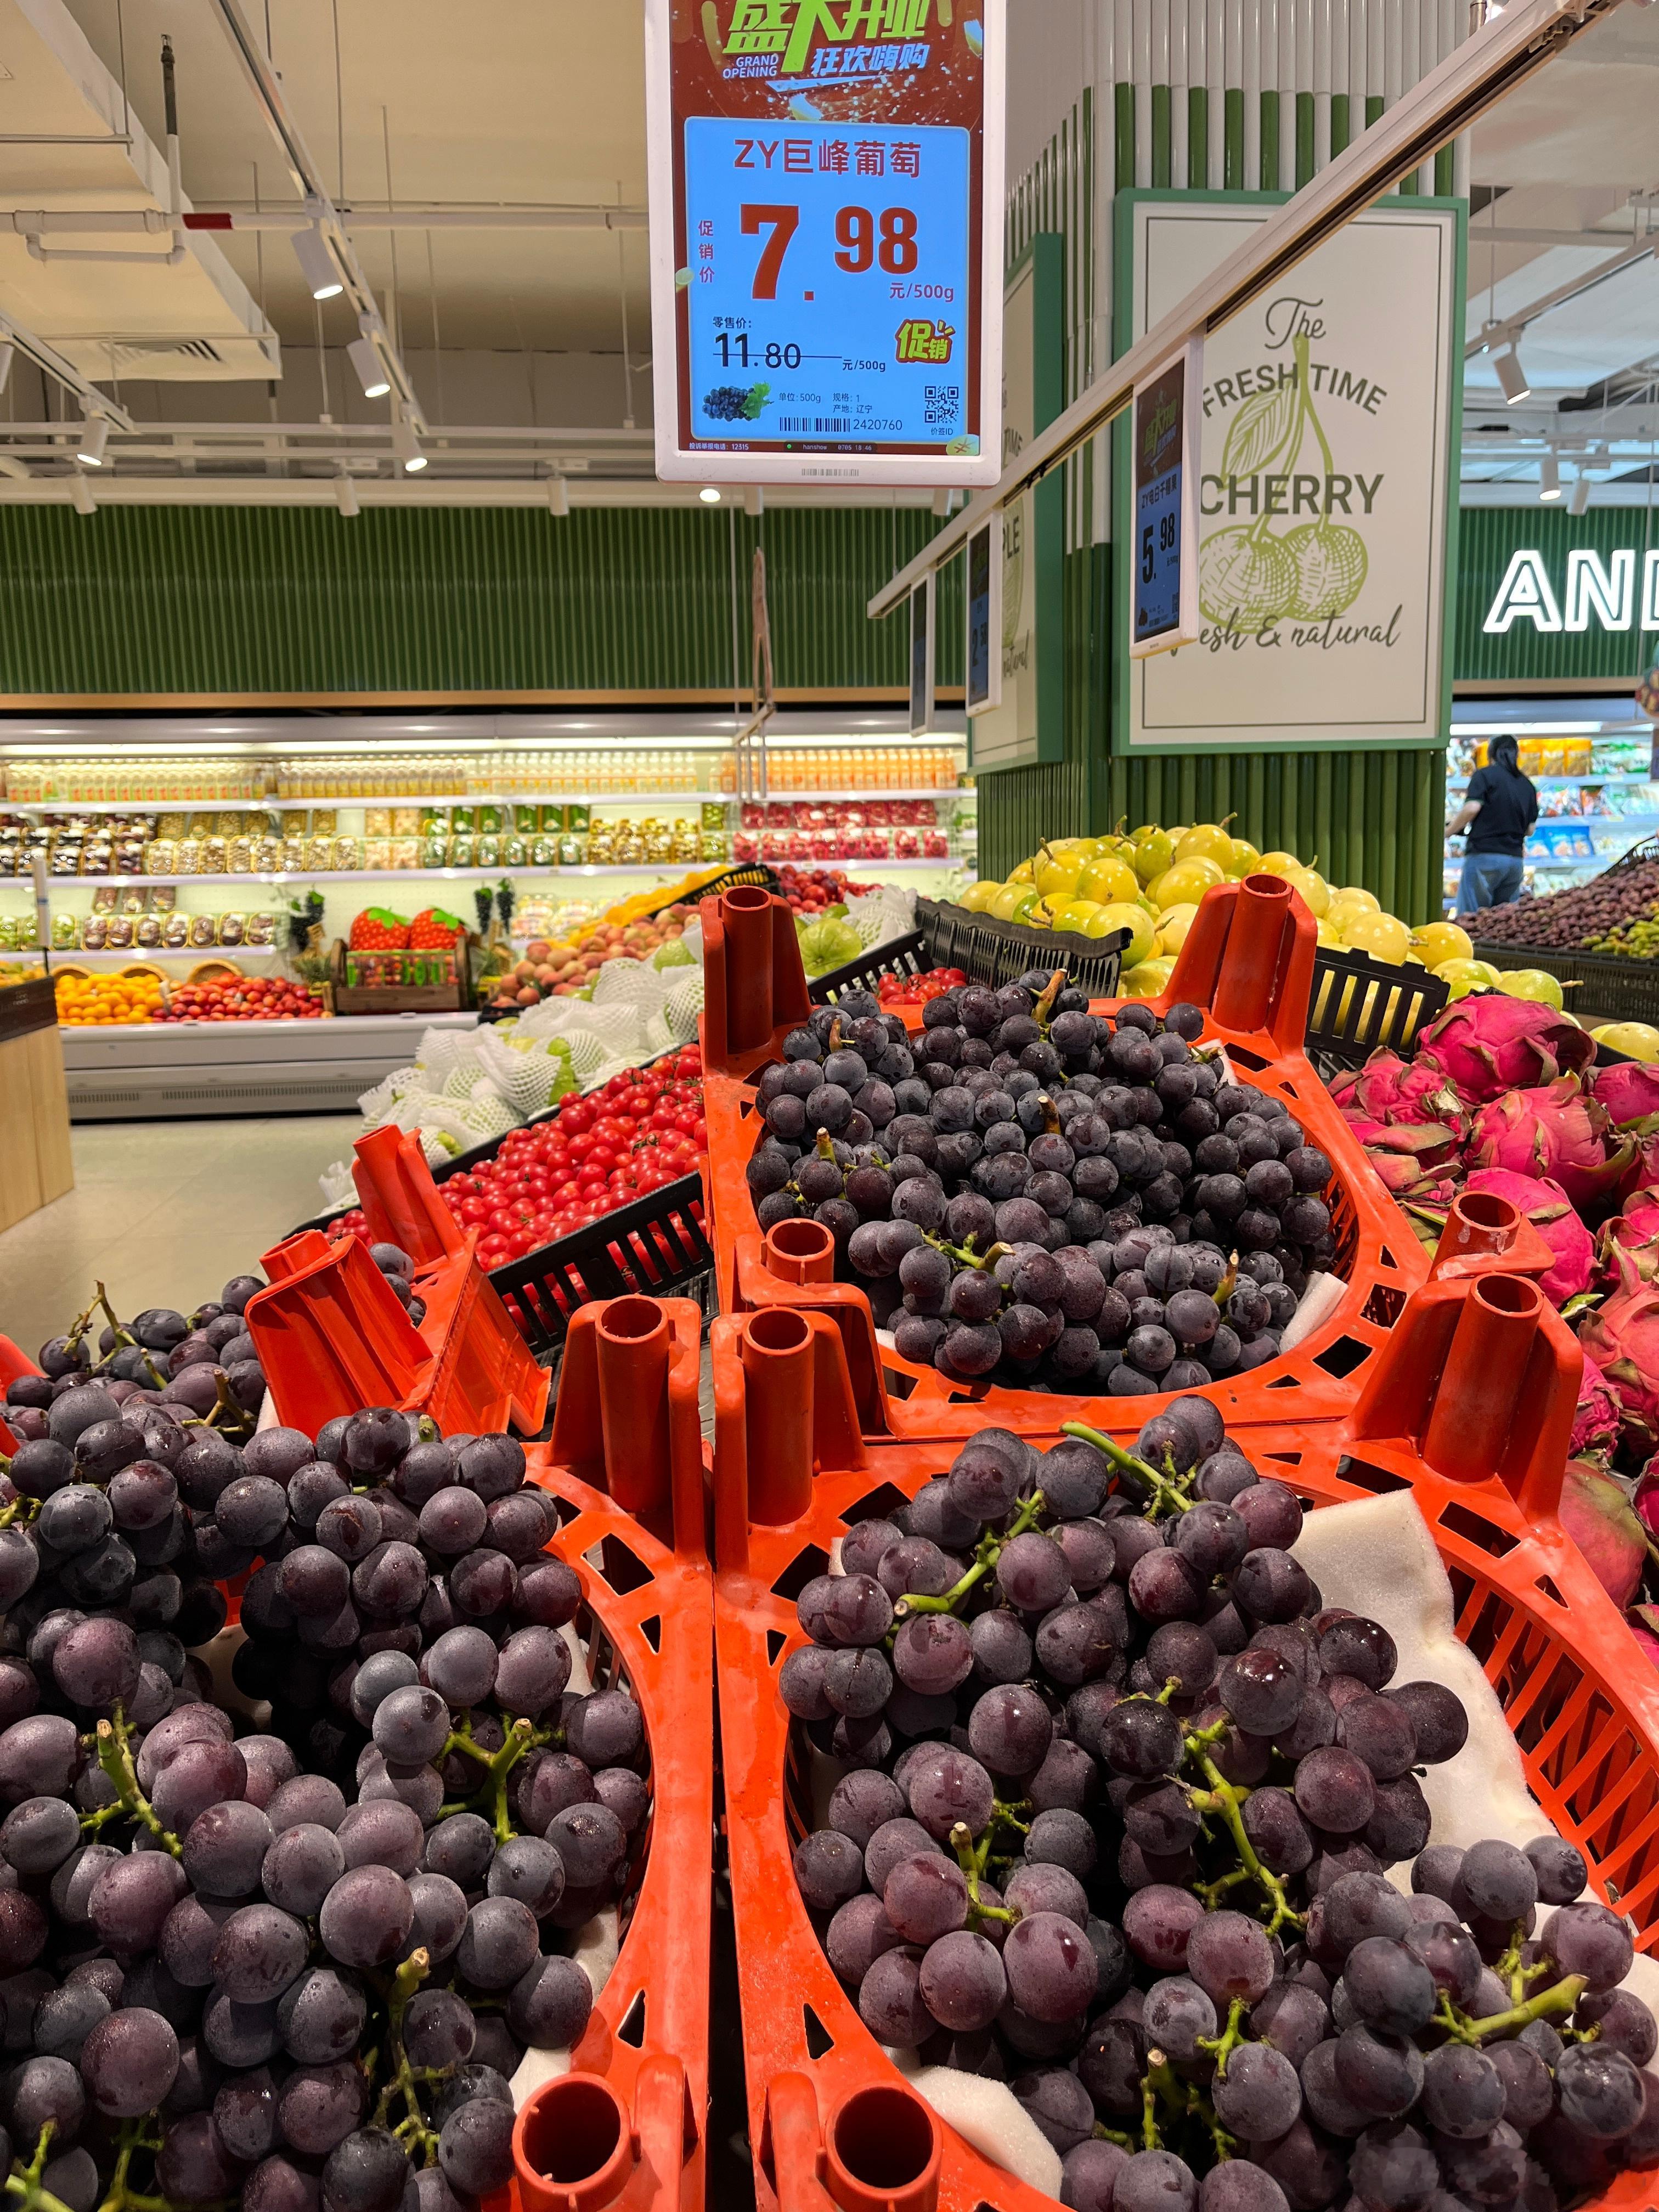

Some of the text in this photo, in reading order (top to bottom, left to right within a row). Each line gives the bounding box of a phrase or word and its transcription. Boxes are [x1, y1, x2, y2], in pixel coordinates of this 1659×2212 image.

[723, 66, 777, 78] OPENING
[736, 53, 778, 68] GRAND
[811, 43, 930, 75] 狂欢嗨购
[734, 139, 921, 178] ZY巨峰葡萄
[889, 283, 954, 302] 元/500g
[898, 322, 949, 360] 促销
[1265, 297, 1326, 349] The
[715, 332, 801, 369] 11.80
[843, 359, 886, 372] 元/500g
[1203, 363, 1387, 417] FRESH TIME
[853, 419, 902, 430] 2420760
[1201, 473, 1384, 515] CHERRY
[1482, 549, 1659, 633] AN
[1256, 614, 1282, 647] &
[1291, 603, 1402, 649] natural
